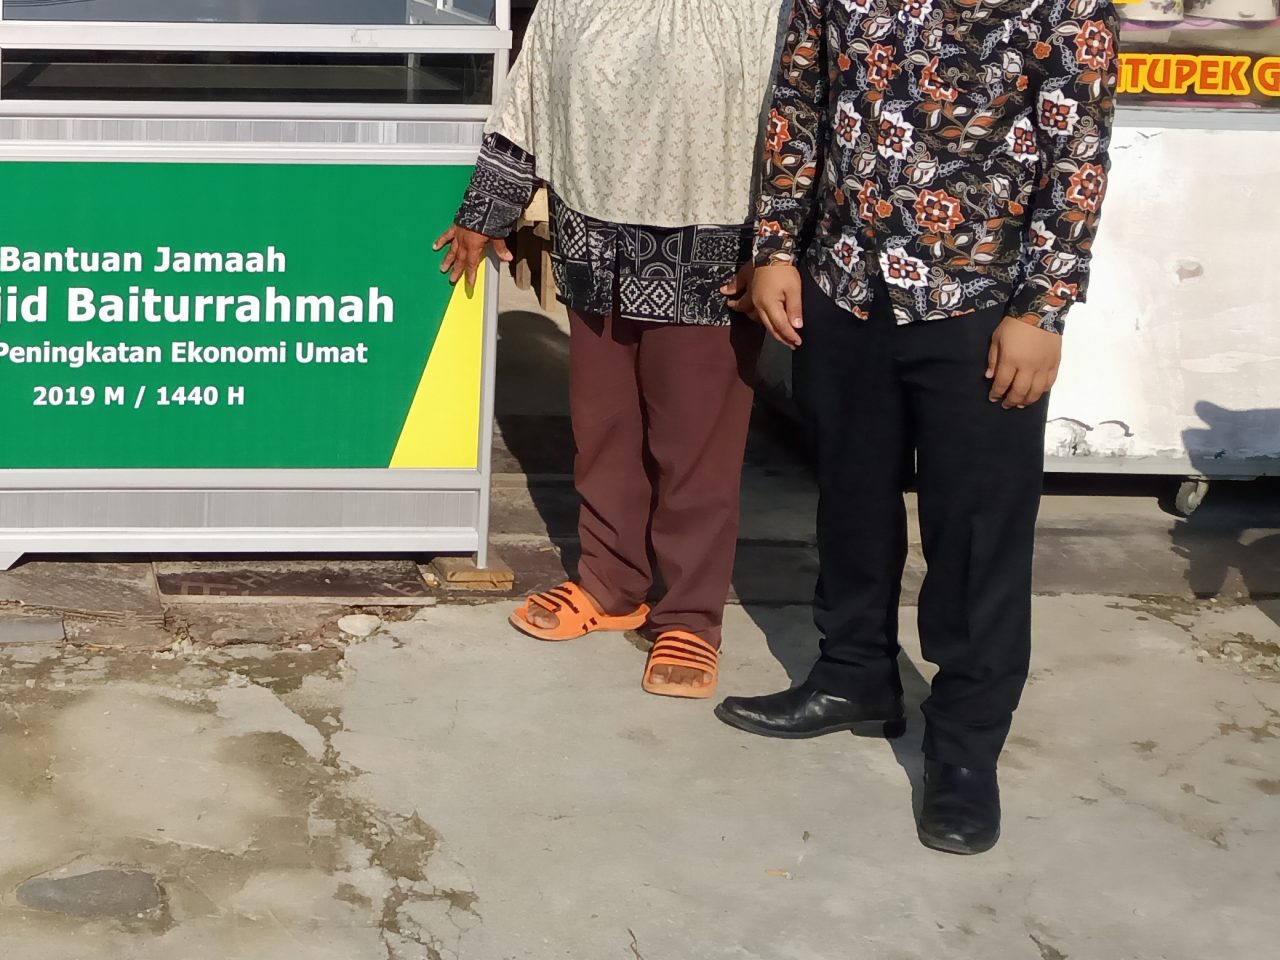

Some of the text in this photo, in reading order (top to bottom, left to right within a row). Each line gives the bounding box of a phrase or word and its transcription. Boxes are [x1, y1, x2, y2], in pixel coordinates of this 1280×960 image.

[1117, 58, 1245, 91] TUPEK
[0, 245, 286, 273] Bantuan Jamaah
[67, 285, 394, 323] Baiturrahmah
[171, 340, 287, 364] Ekonomi
[295, 341, 368, 364] Umat
[33, 385, 245, 410] 2019 M / 1440 H
